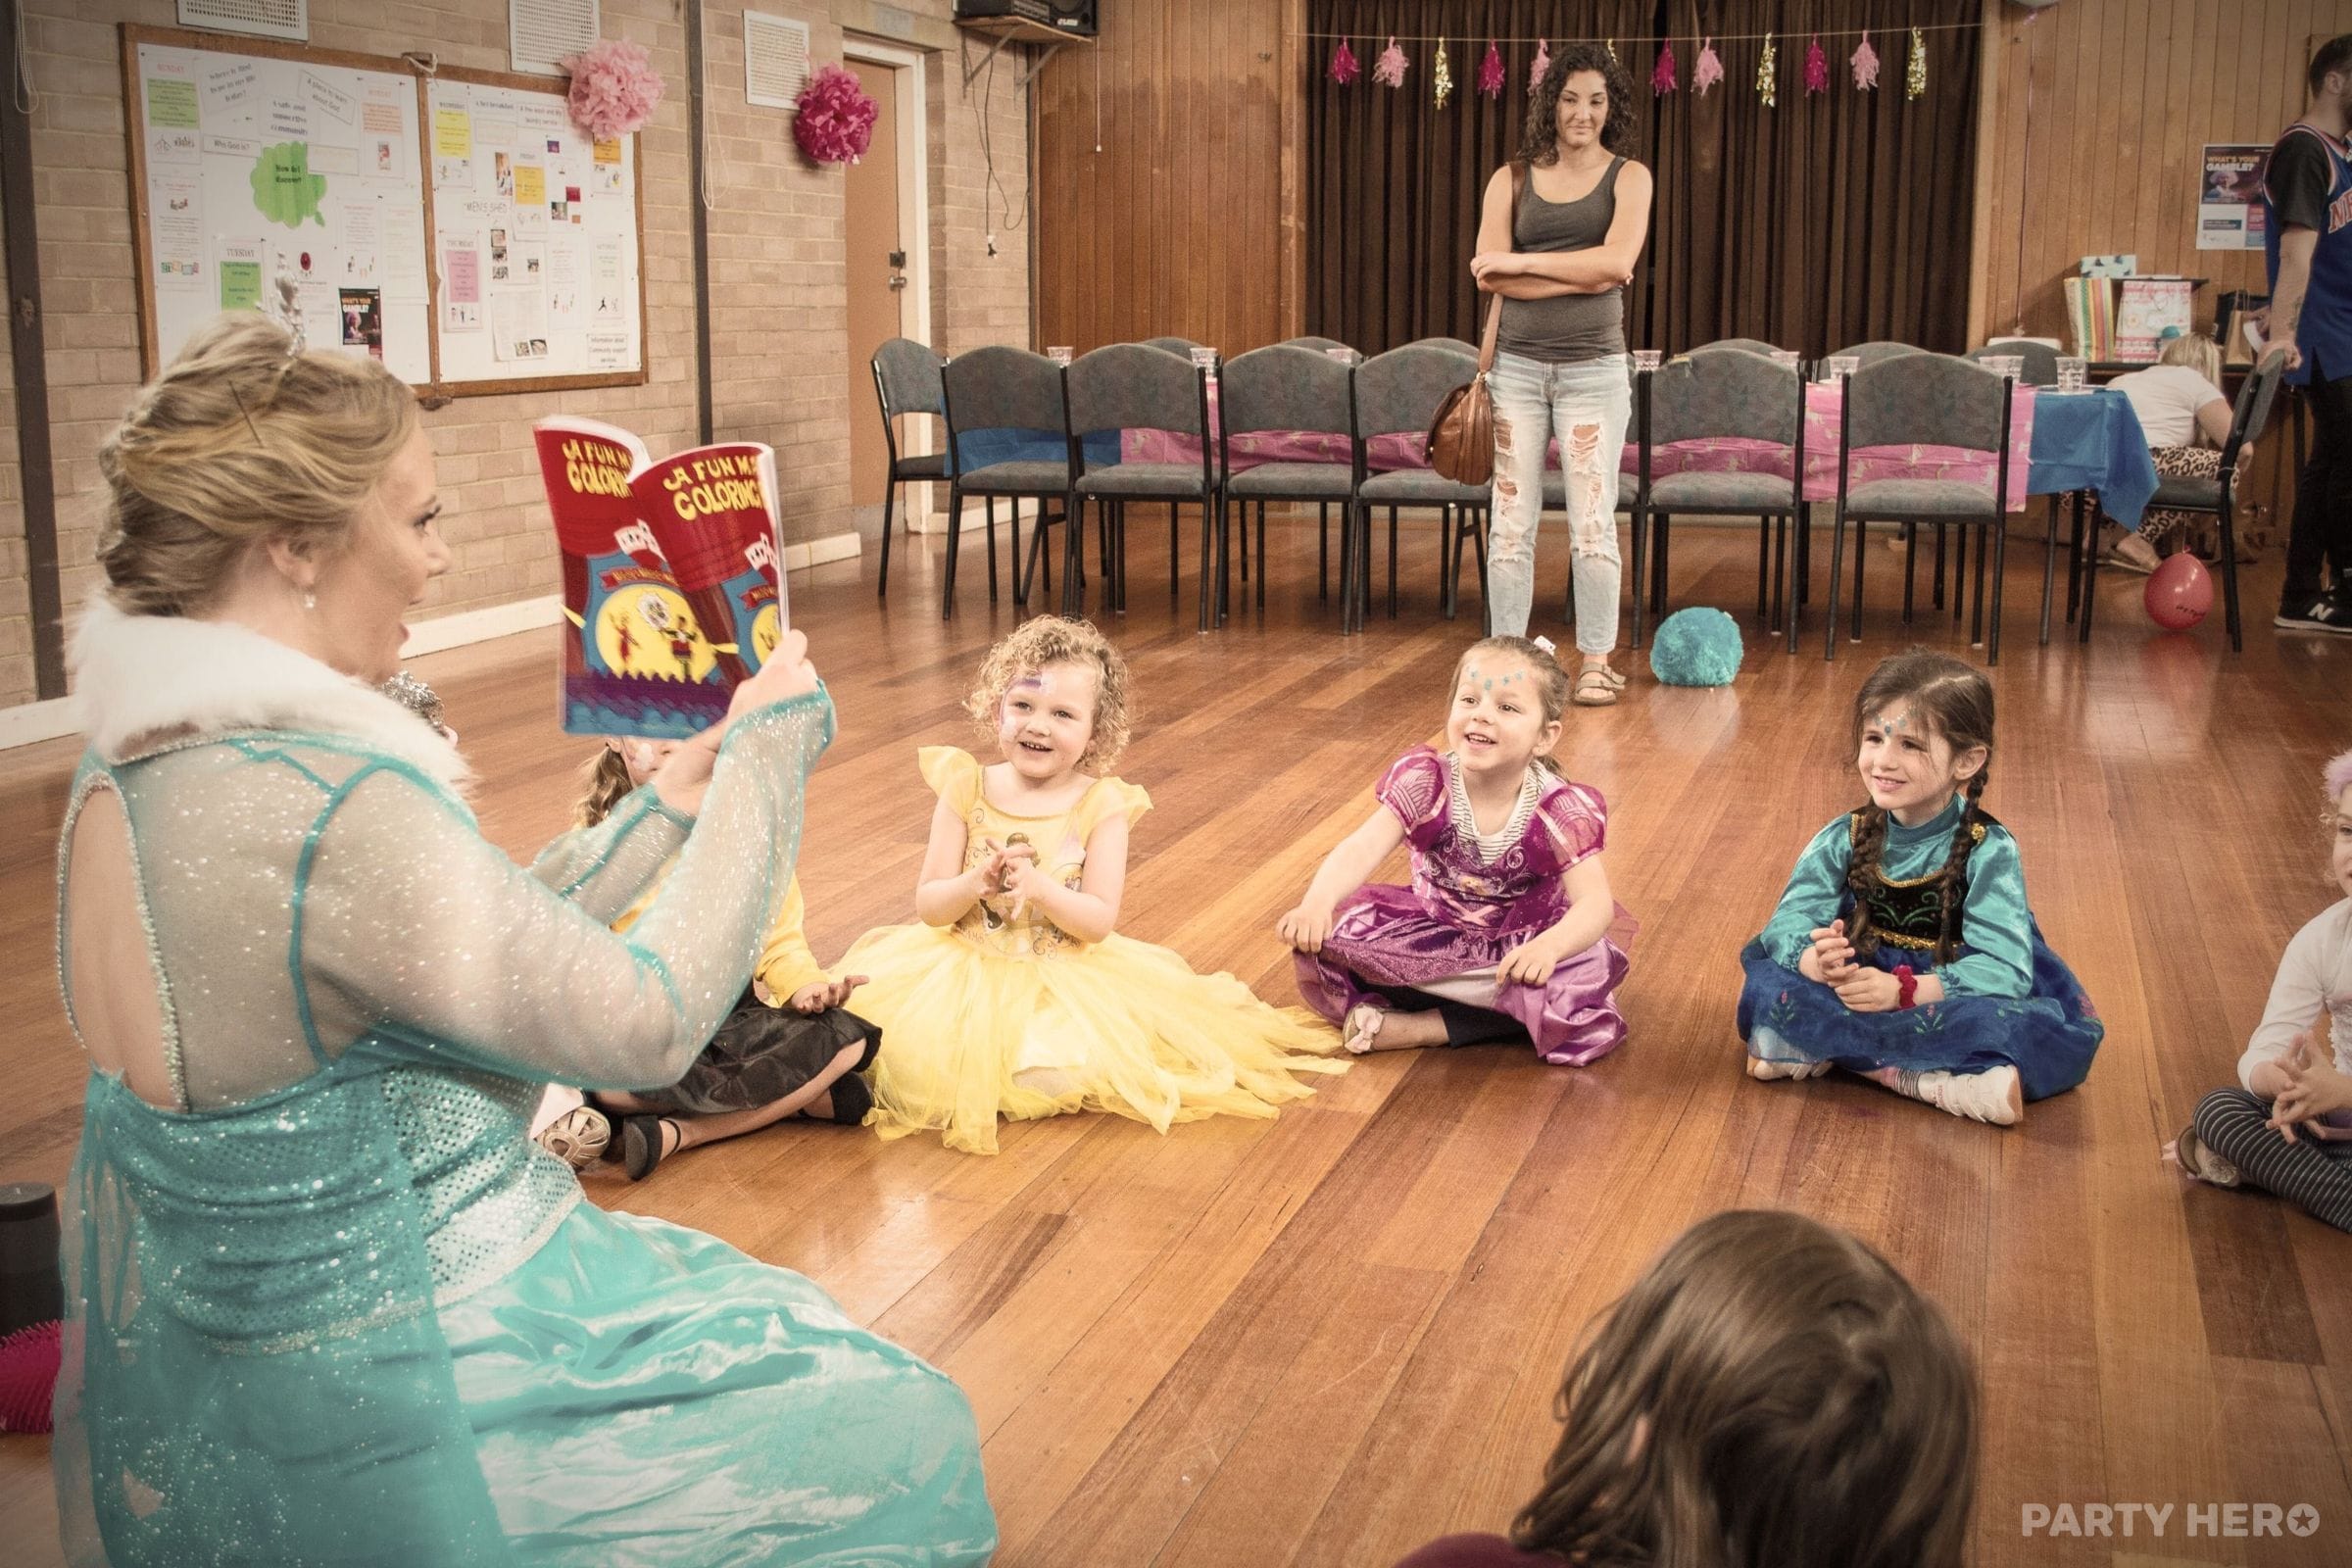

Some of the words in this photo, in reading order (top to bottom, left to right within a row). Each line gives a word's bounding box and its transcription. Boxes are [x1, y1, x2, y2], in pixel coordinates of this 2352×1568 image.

[2206, 163, 2254, 172] GAMBLE?
[562, 439, 584, 462] A
[583, 440, 618, 467] FUN
[662, 466, 694, 491] A
[691, 456, 737, 481] FUN
